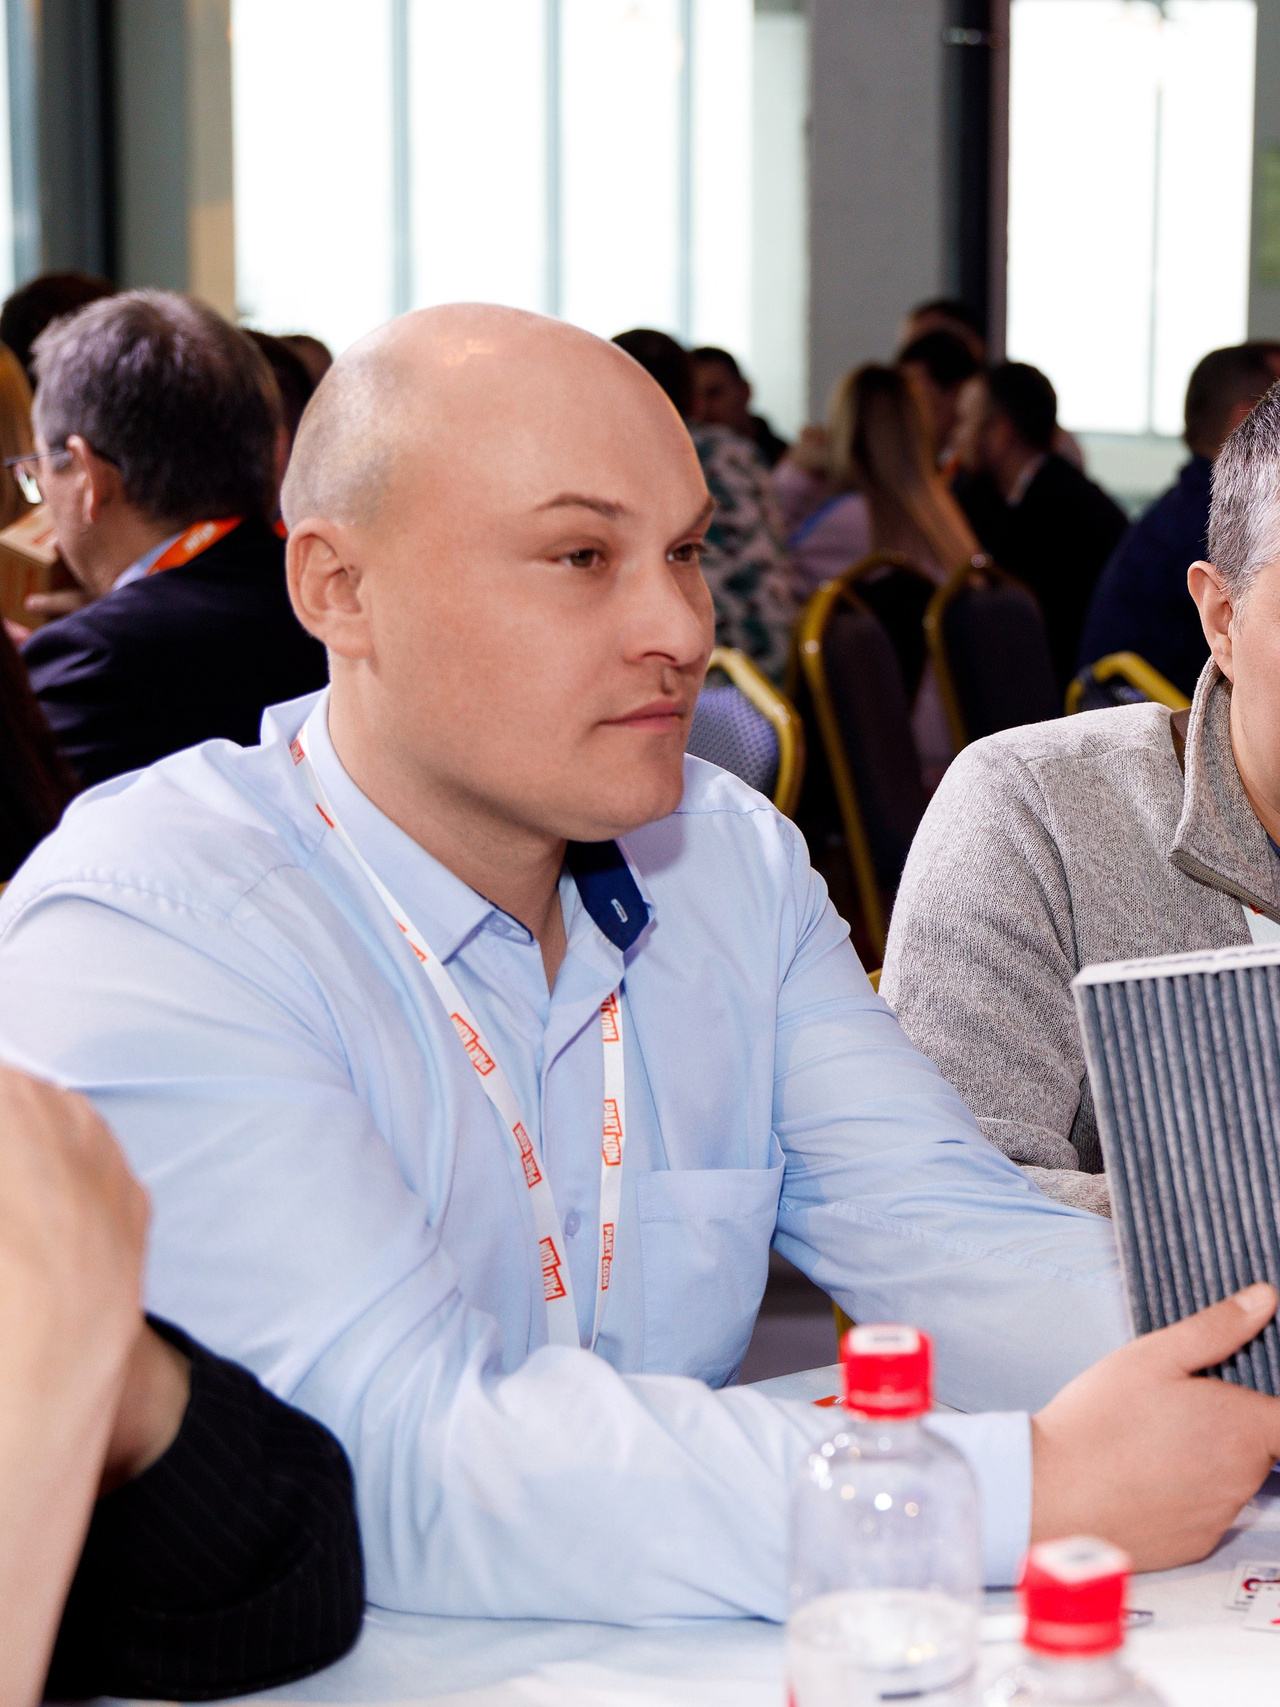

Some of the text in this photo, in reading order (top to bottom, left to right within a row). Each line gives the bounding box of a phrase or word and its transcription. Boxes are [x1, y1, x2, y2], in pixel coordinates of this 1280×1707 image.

[603, 1101, 620, 1163] PART KOM
[522, 1154, 541, 1186] PART
[603, 1225, 613, 1257] PART
